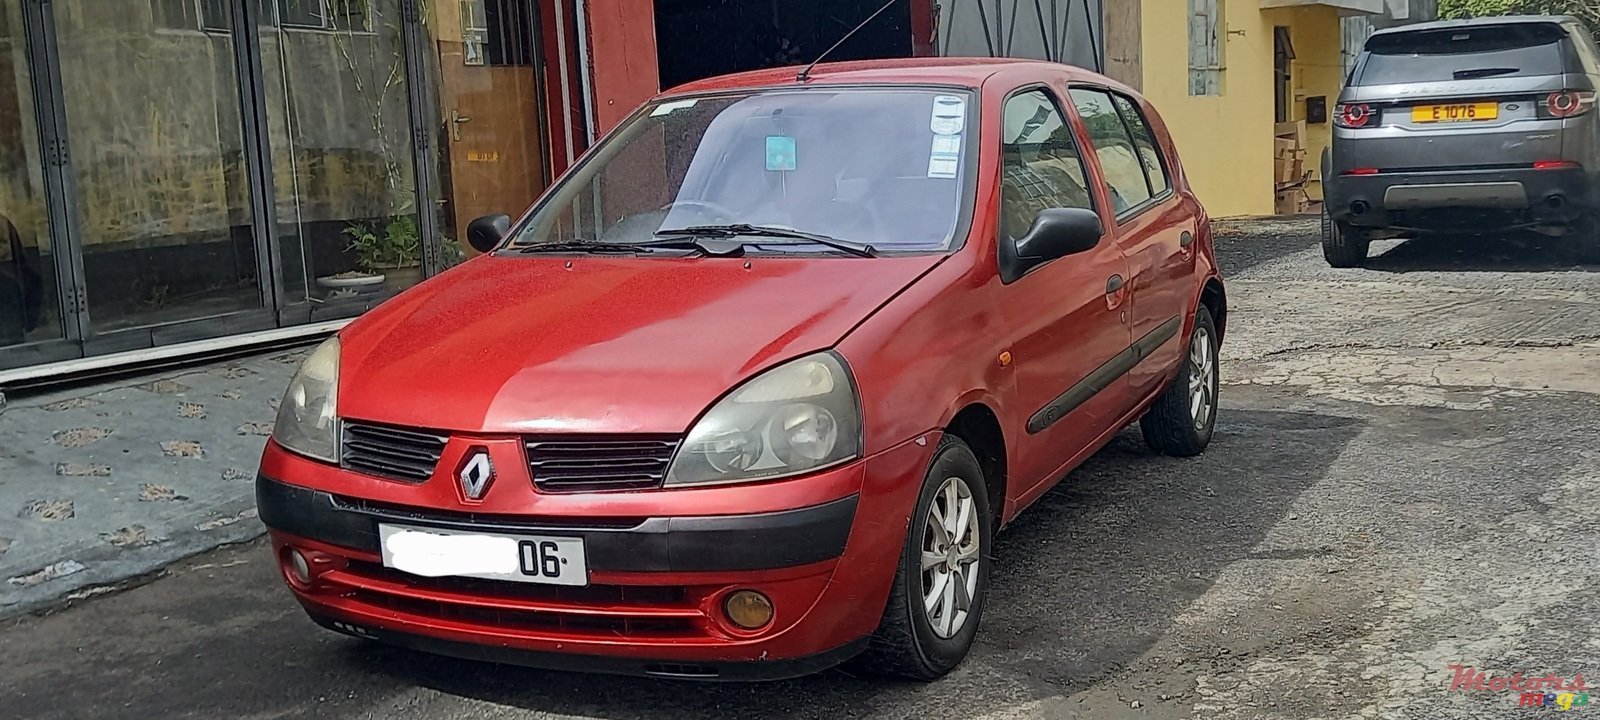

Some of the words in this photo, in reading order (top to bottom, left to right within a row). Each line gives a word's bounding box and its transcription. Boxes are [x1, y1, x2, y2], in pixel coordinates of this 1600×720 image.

[1433, 106, 1440, 119] E
[1444, 105, 1475, 119] 1076
[518, 540, 560, 577] 06
